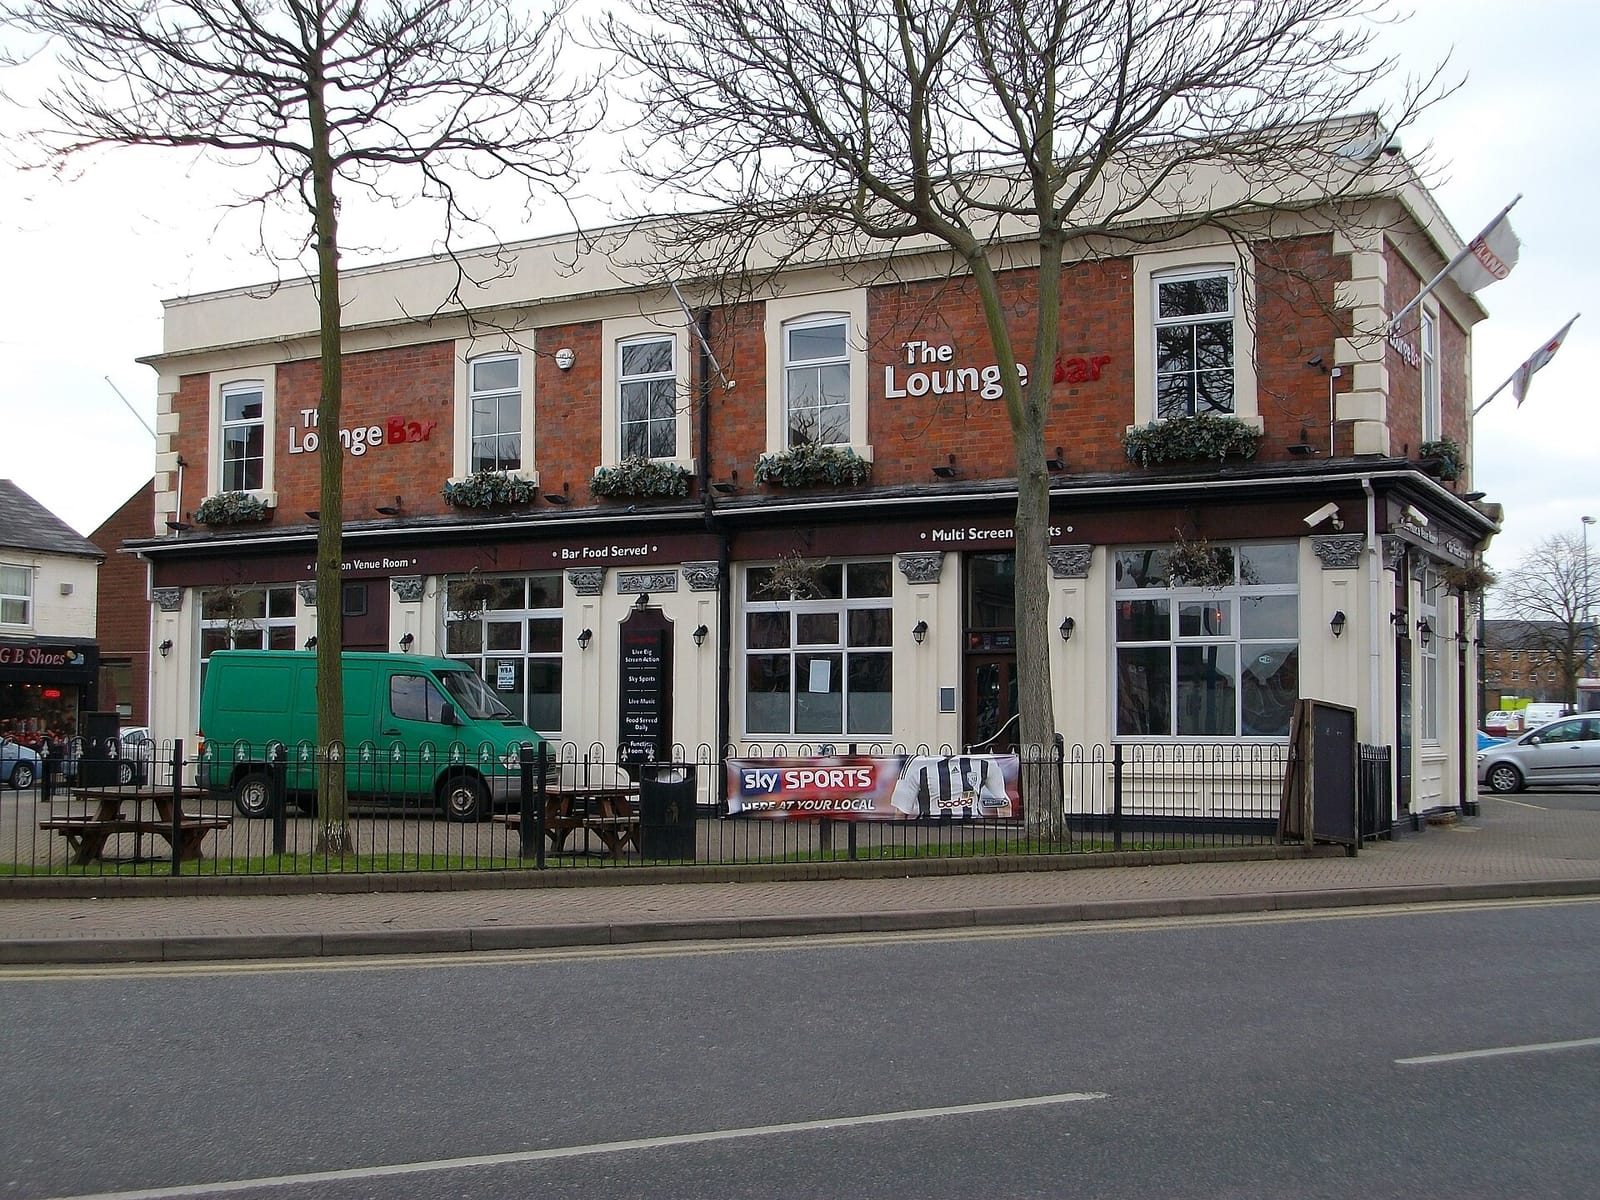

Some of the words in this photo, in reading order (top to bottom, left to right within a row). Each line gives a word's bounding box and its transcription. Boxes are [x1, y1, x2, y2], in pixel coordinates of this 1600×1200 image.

[902, 341, 953, 364] The
[300, 408, 321, 428] Th
[289, 425, 383, 456] Longe
[387, 415, 437, 444] Bar
[932, 528, 965, 541] Multi
[968, 527, 1014, 540] Screen
[561, 548, 580, 560] Bar
[582, 546, 608, 558] Food
[611, 544, 648, 557] Served
[353, 559, 381, 570] Venue
[382, 558, 409, 569] Room
[0, 647, 11, 663] G
[13, 648, 25, 664] B
[27, 648, 66, 665] Shoes
[639, 675, 656, 683] Sports
[639, 697, 656, 705] Music
[639, 716, 658, 724] Served
[634, 724, 648, 732] Daily
[744, 769, 778, 793] sky
[785, 769, 872, 790] SPORTS
[776, 800, 795, 810] AT
[796, 800, 831, 811] YOUR
[834, 799, 875, 811] LOCAL
[937, 796, 974, 809] bodog
